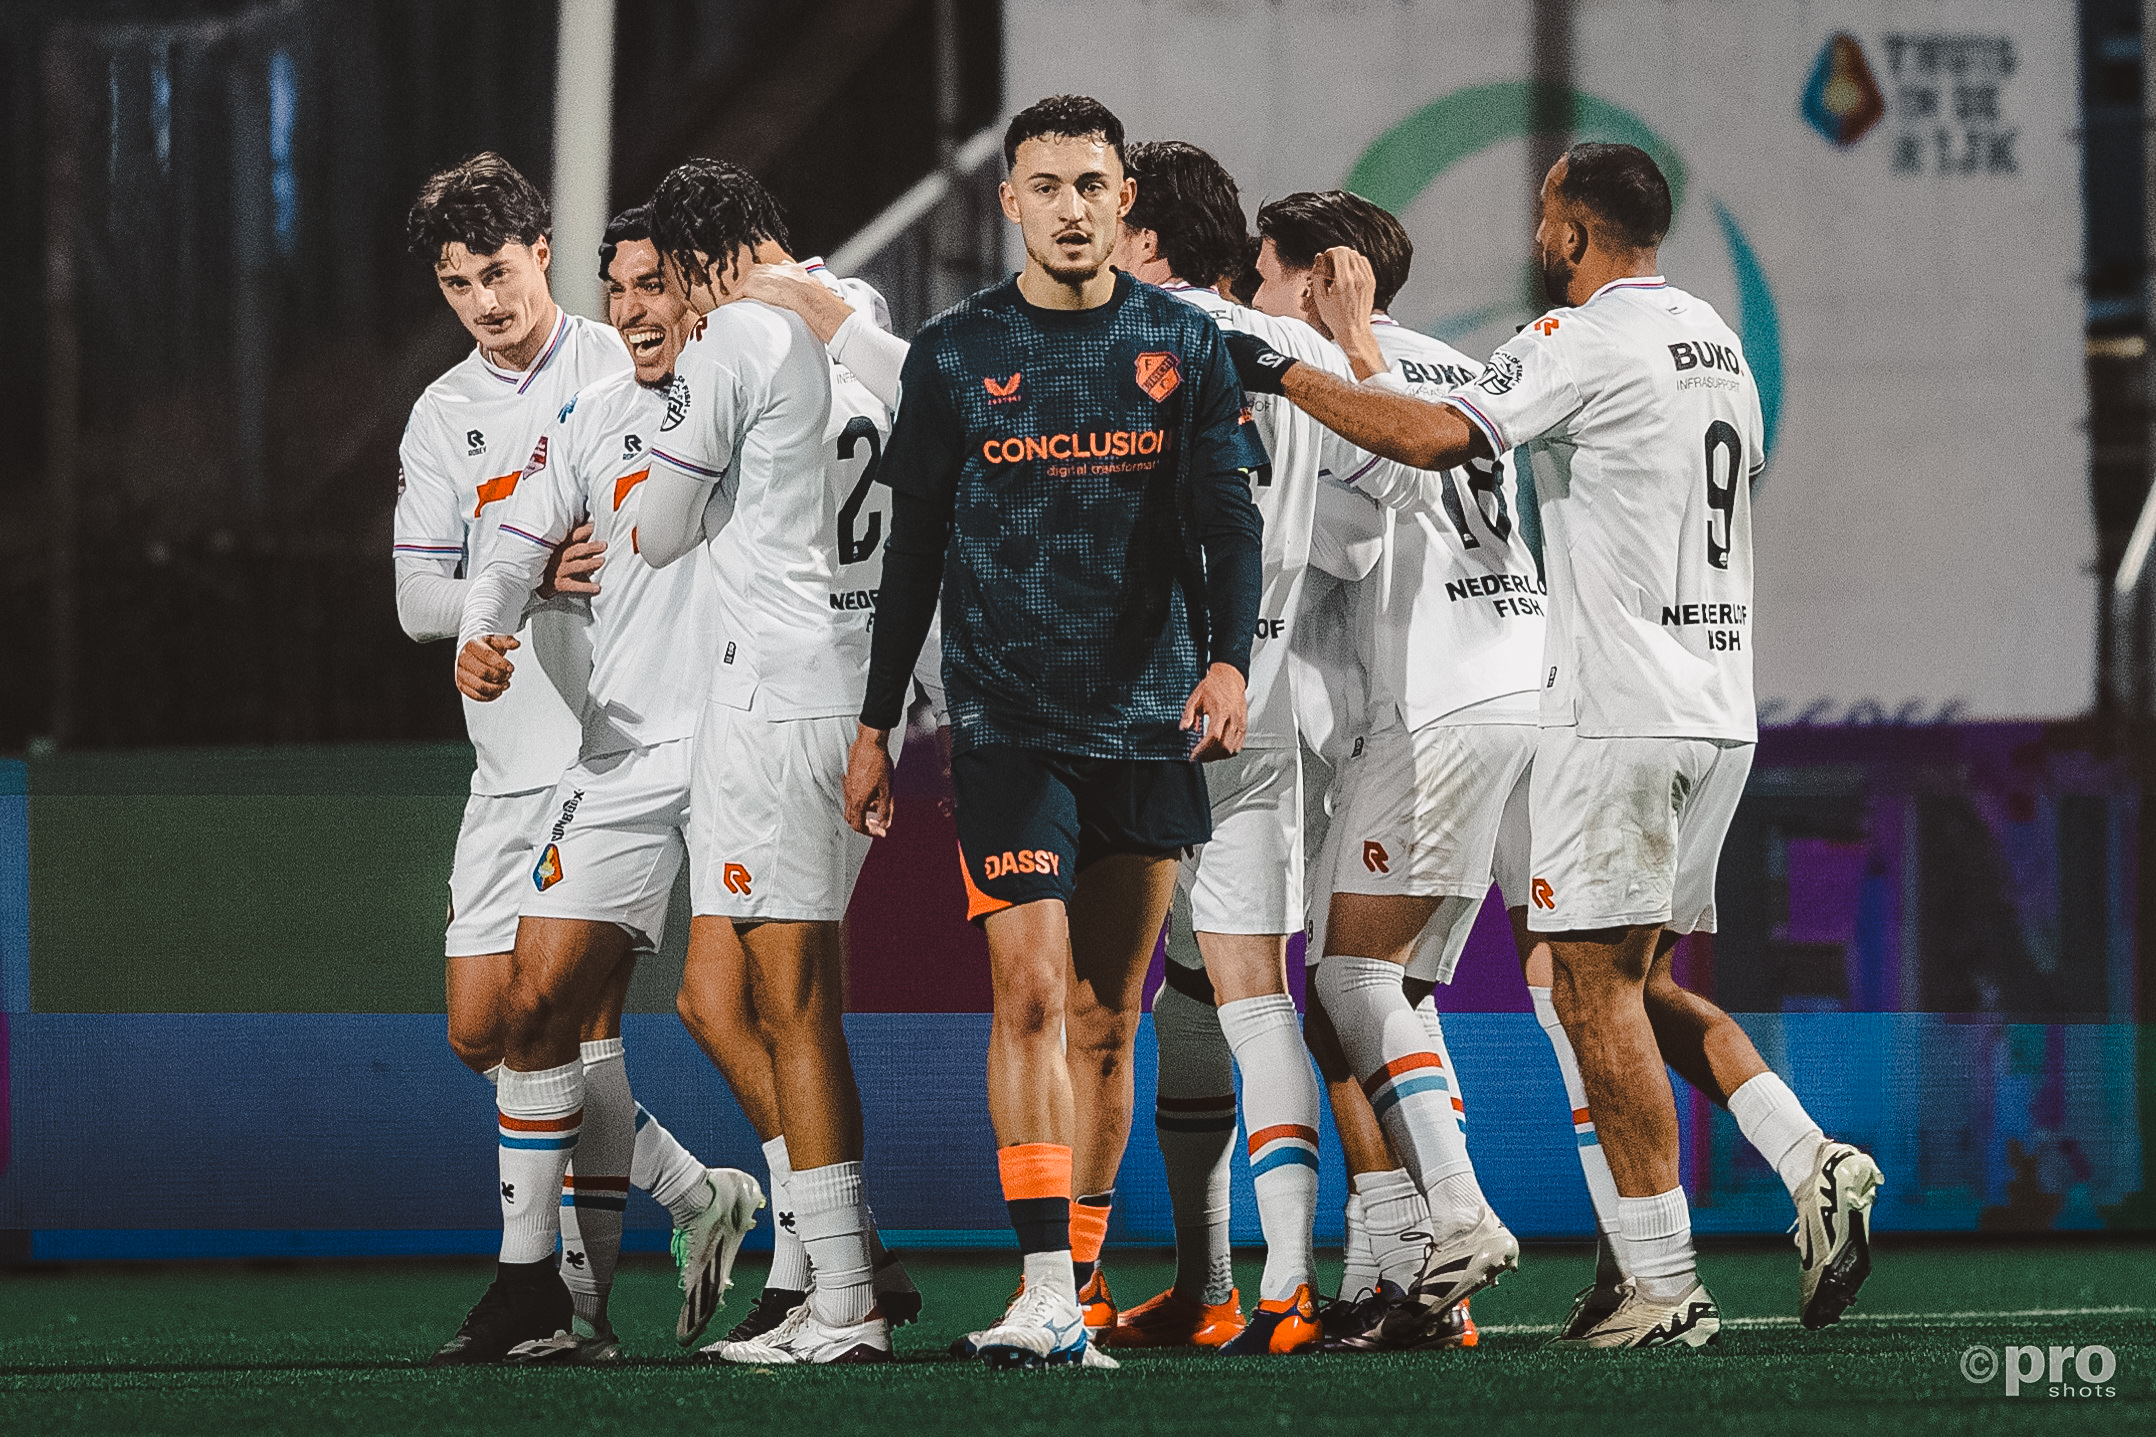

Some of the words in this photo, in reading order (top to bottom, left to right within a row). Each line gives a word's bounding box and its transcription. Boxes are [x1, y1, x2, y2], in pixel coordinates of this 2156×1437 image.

[837, 416, 882, 566] 2
[1704, 420, 1742, 570] 9
[1493, 597, 1544, 617] FISH
[984, 849, 1059, 880] DASSY
